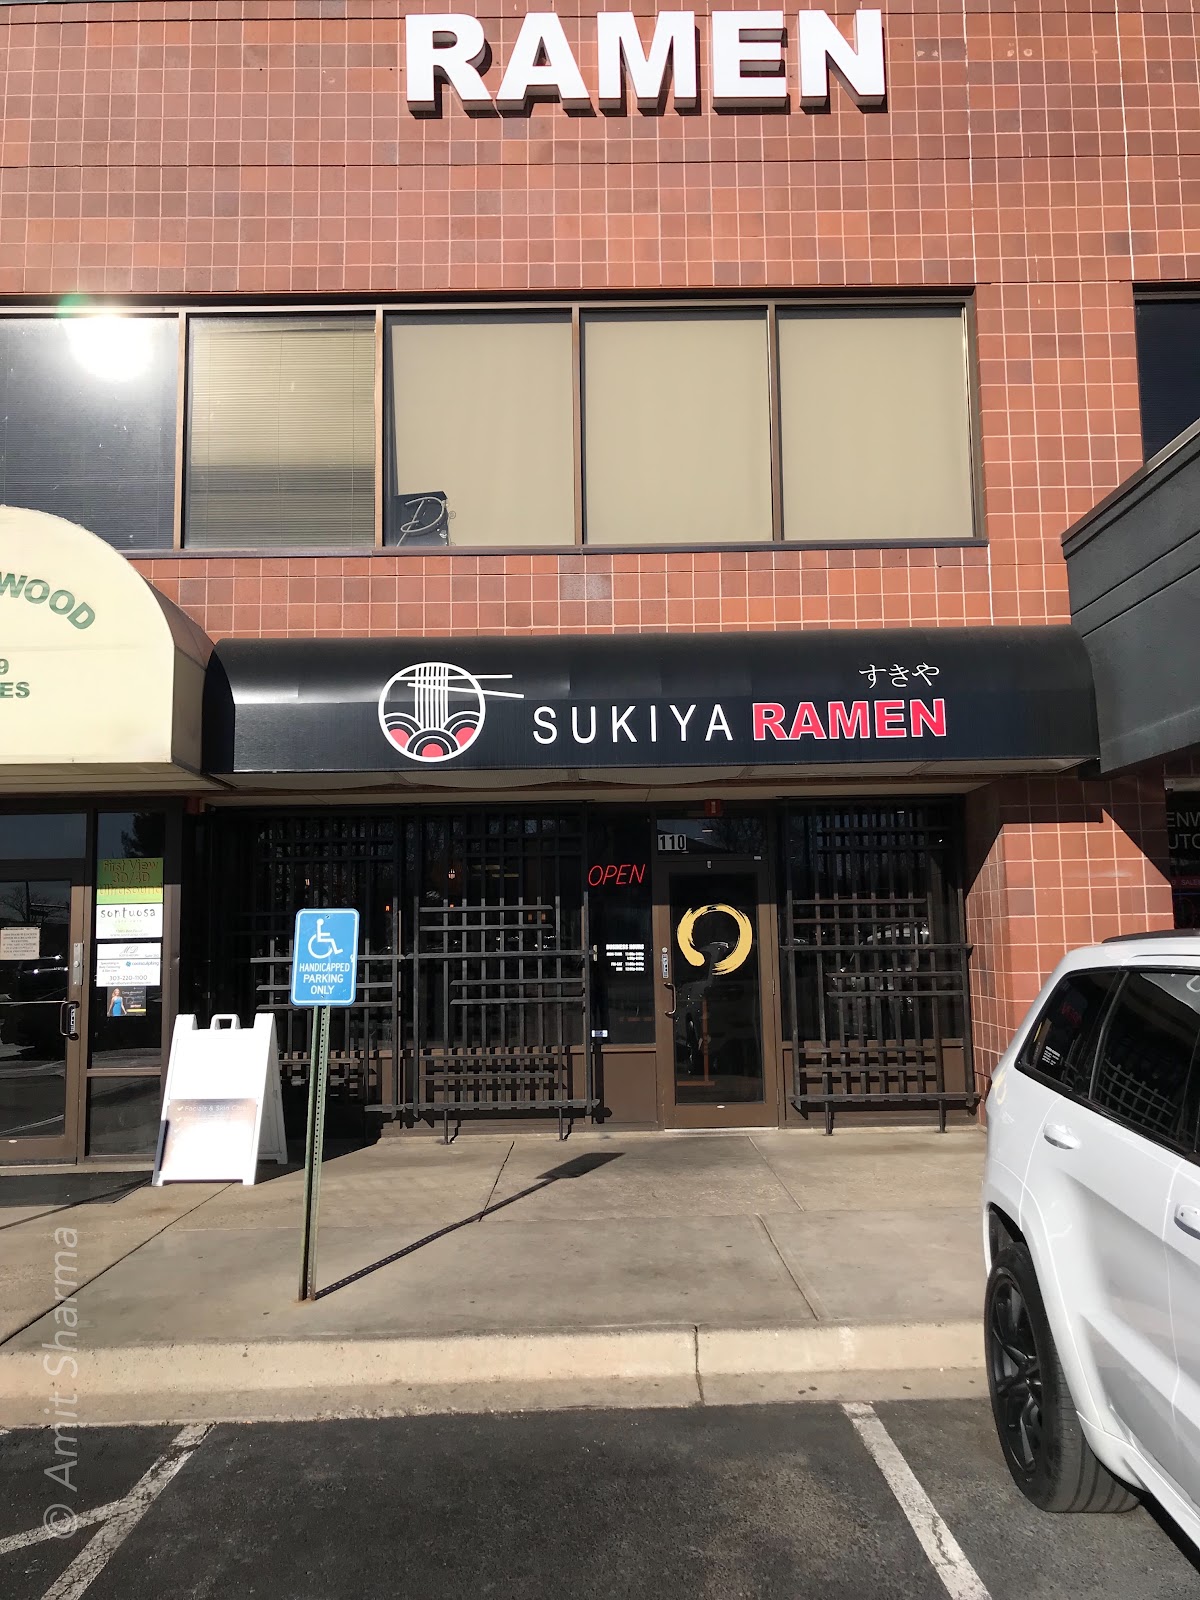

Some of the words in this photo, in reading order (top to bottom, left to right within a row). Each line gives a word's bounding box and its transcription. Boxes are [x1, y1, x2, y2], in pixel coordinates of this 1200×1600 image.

[405, 9, 886, 108] RAMEN
[858, 662, 940, 689] すきや
[532, 703, 734, 745] SUKIYA
[751, 698, 947, 741] RAMEN
[659, 834, 686, 850] 110
[588, 864, 646, 886] OPEN
[100, 907, 156, 918] sontuosa
[299, 963, 350, 972] HANDICAPPED
[303, 974, 344, 983] PARKING
[310, 985, 335, 995] ONLY
